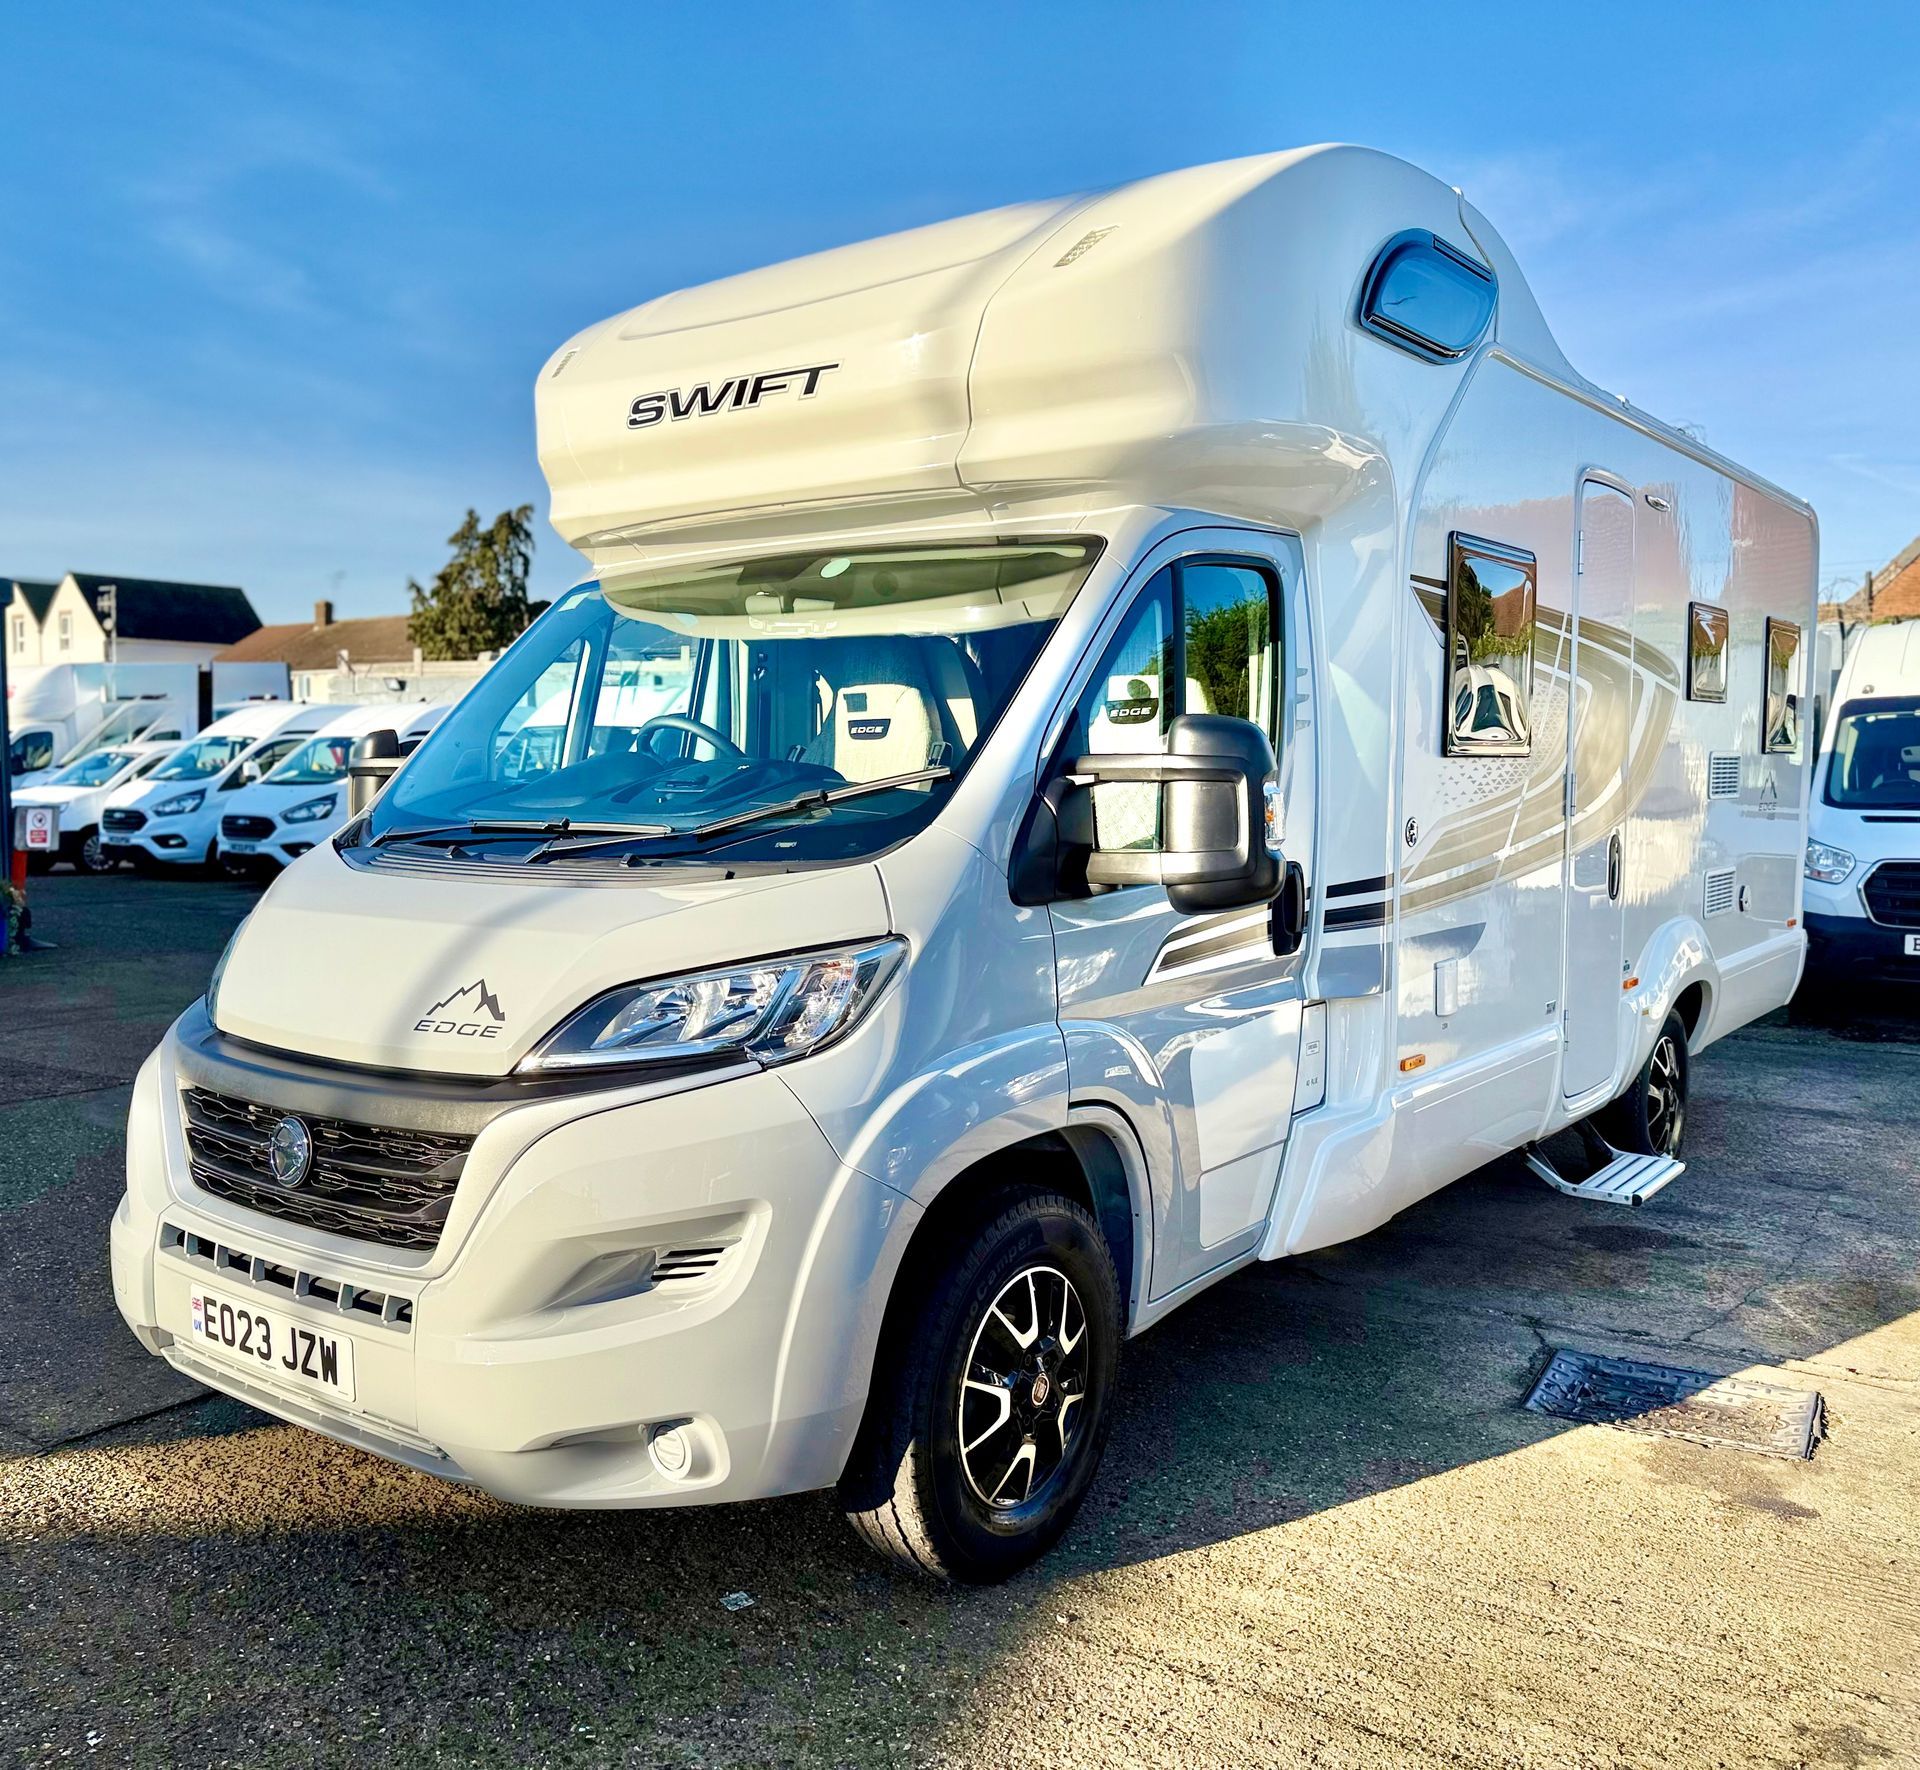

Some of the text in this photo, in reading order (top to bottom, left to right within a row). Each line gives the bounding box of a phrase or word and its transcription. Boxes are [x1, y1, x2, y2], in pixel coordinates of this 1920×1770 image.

[627, 361, 841, 428] SWIFT
[1109, 706, 1152, 718] EDGE
[850, 726, 884, 735] EDGE
[413, 1020, 503, 1038] EDGE
[282, 1327, 338, 1386] JZW
